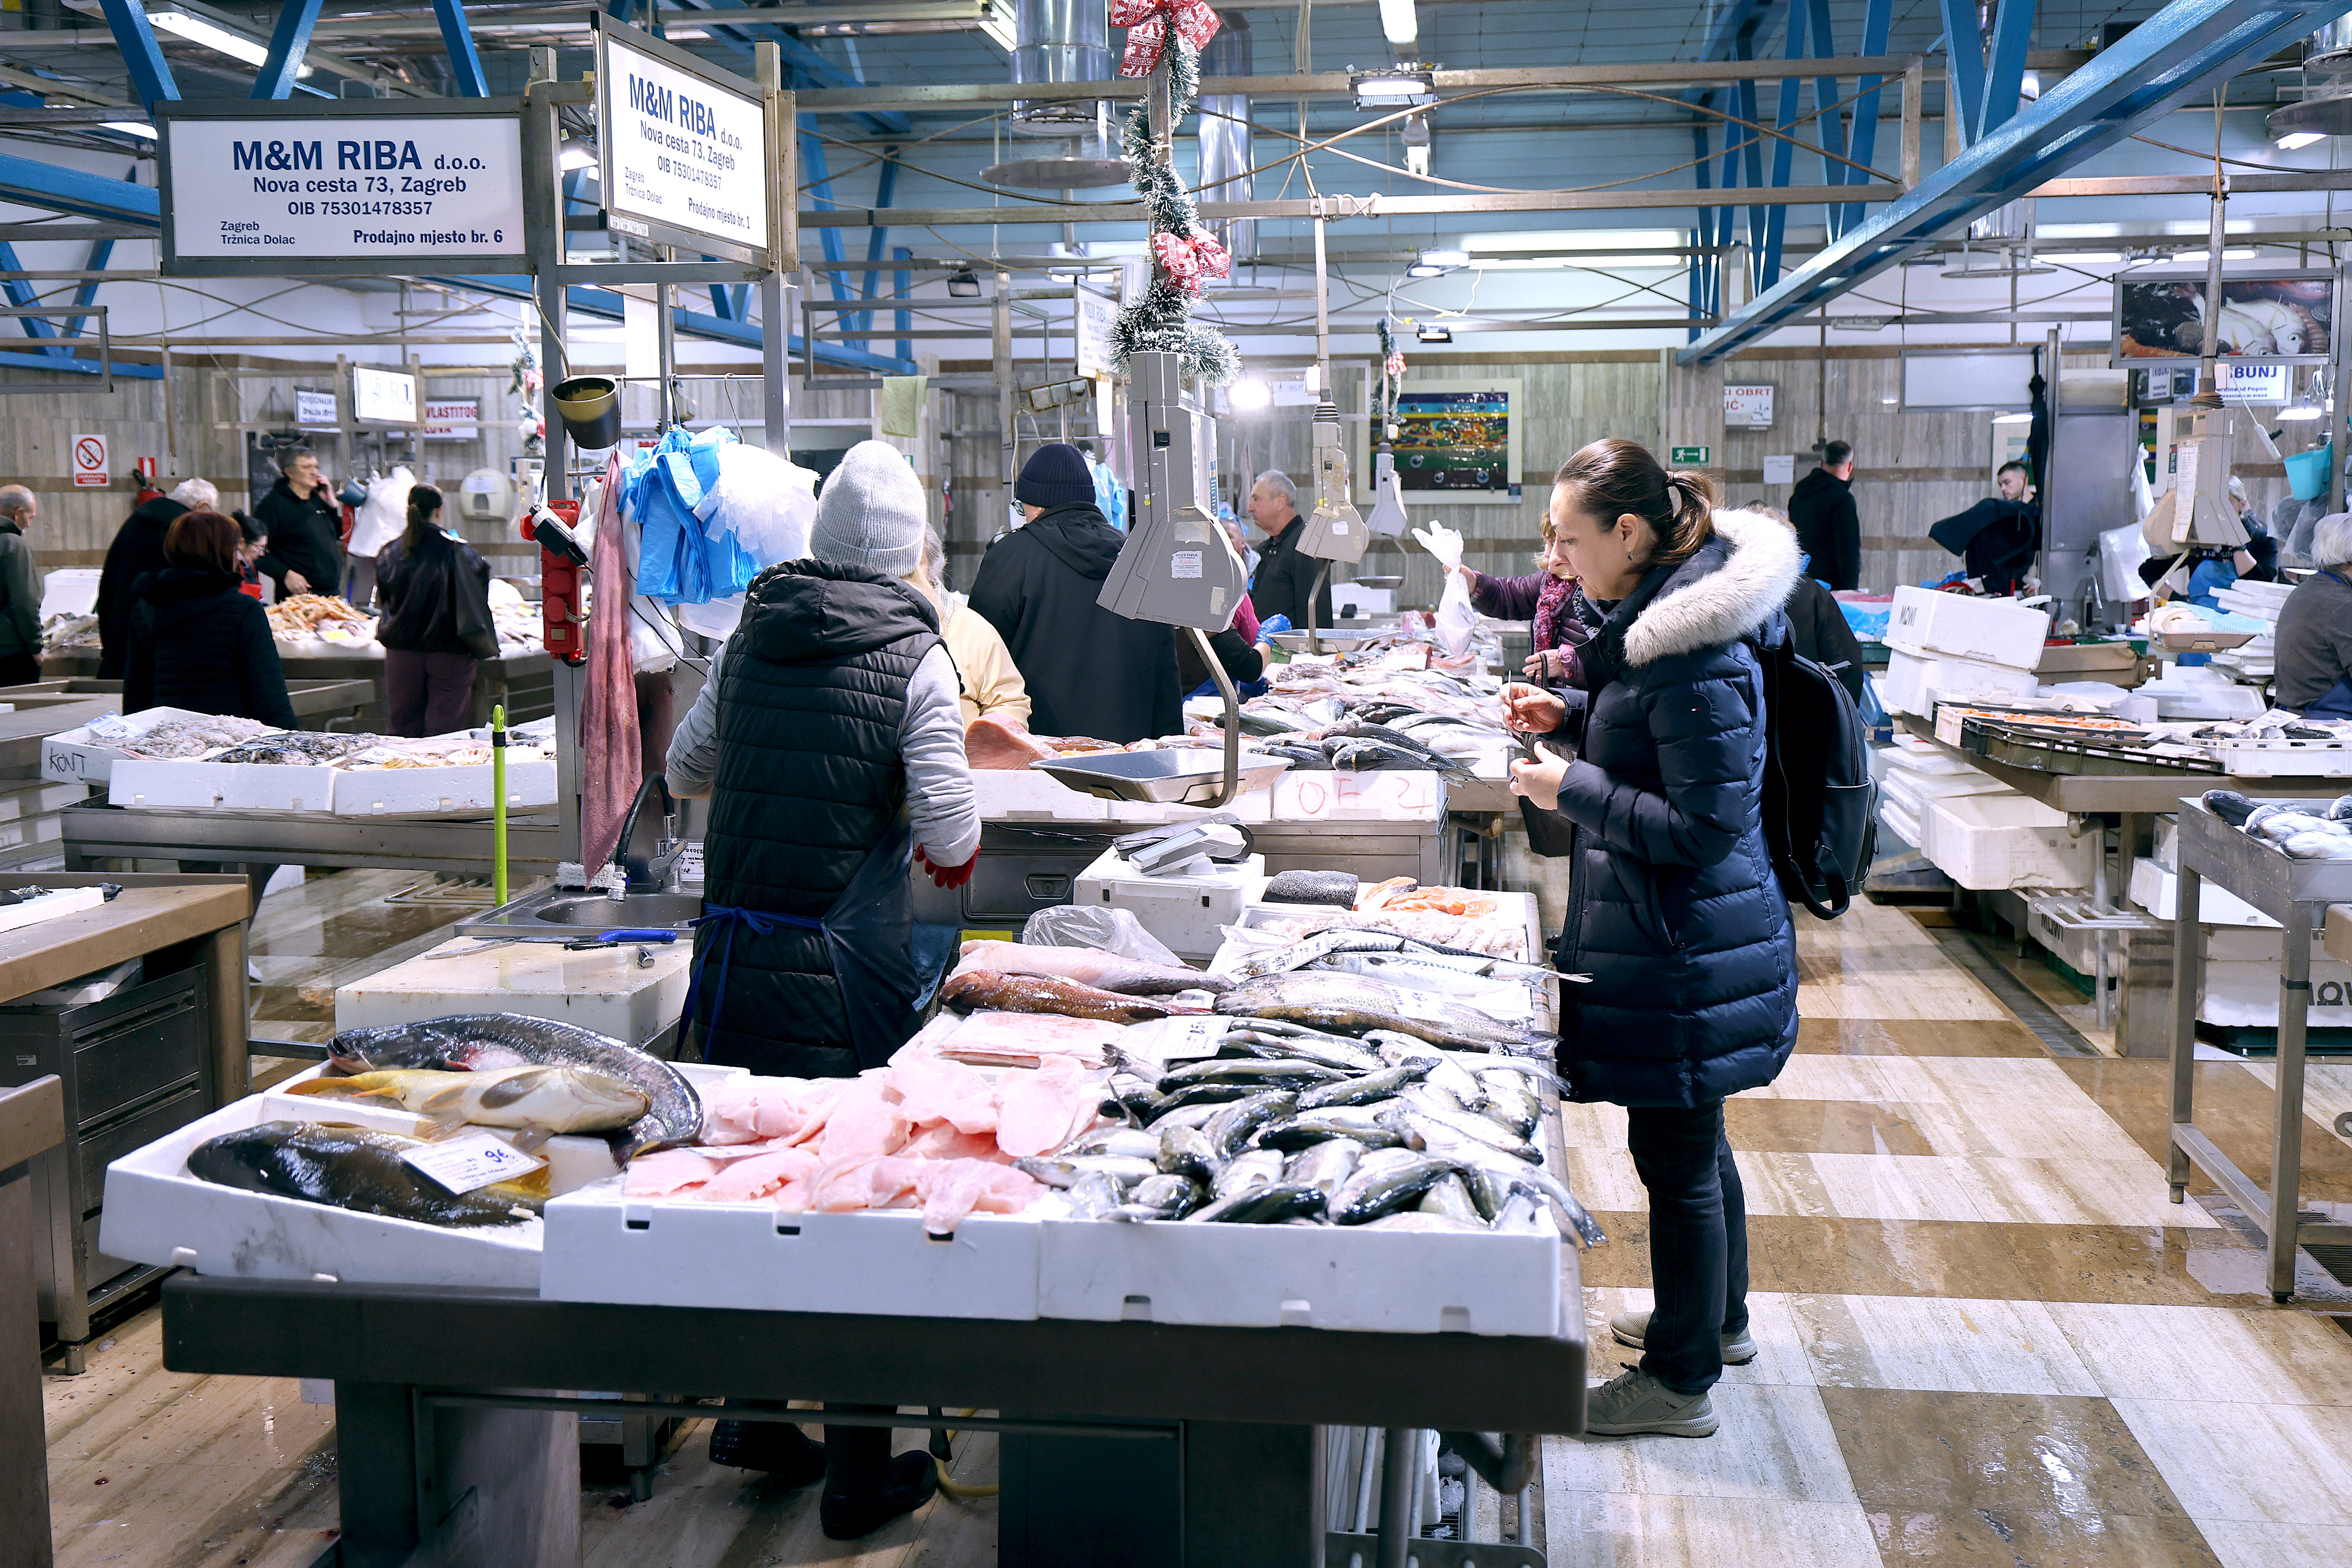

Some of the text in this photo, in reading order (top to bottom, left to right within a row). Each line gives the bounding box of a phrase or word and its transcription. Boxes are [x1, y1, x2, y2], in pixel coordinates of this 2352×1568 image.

[629, 73, 743, 151] M&M RIBA d.o.o.
[233, 141, 486, 170] M&M RIBA d.o.o.
[640, 119, 735, 171] Nova cesta 73, Zagreb
[624, 167, 644, 183] Zagreb
[657, 155, 721, 190] OIB 75301478357
[253, 176, 466, 196] Nova cesta 73, Zagreb
[625, 183, 662, 205] Tržnica Dolac
[288, 201, 433, 215] OIB 75301478357
[689, 197, 750, 229] Prodajno mjesto br. 1
[220, 220, 260, 233] Zagreb
[220, 234, 296, 245] Tržnica Dolac
[353, 229, 503, 246] Prodajno mjesto br. 6
